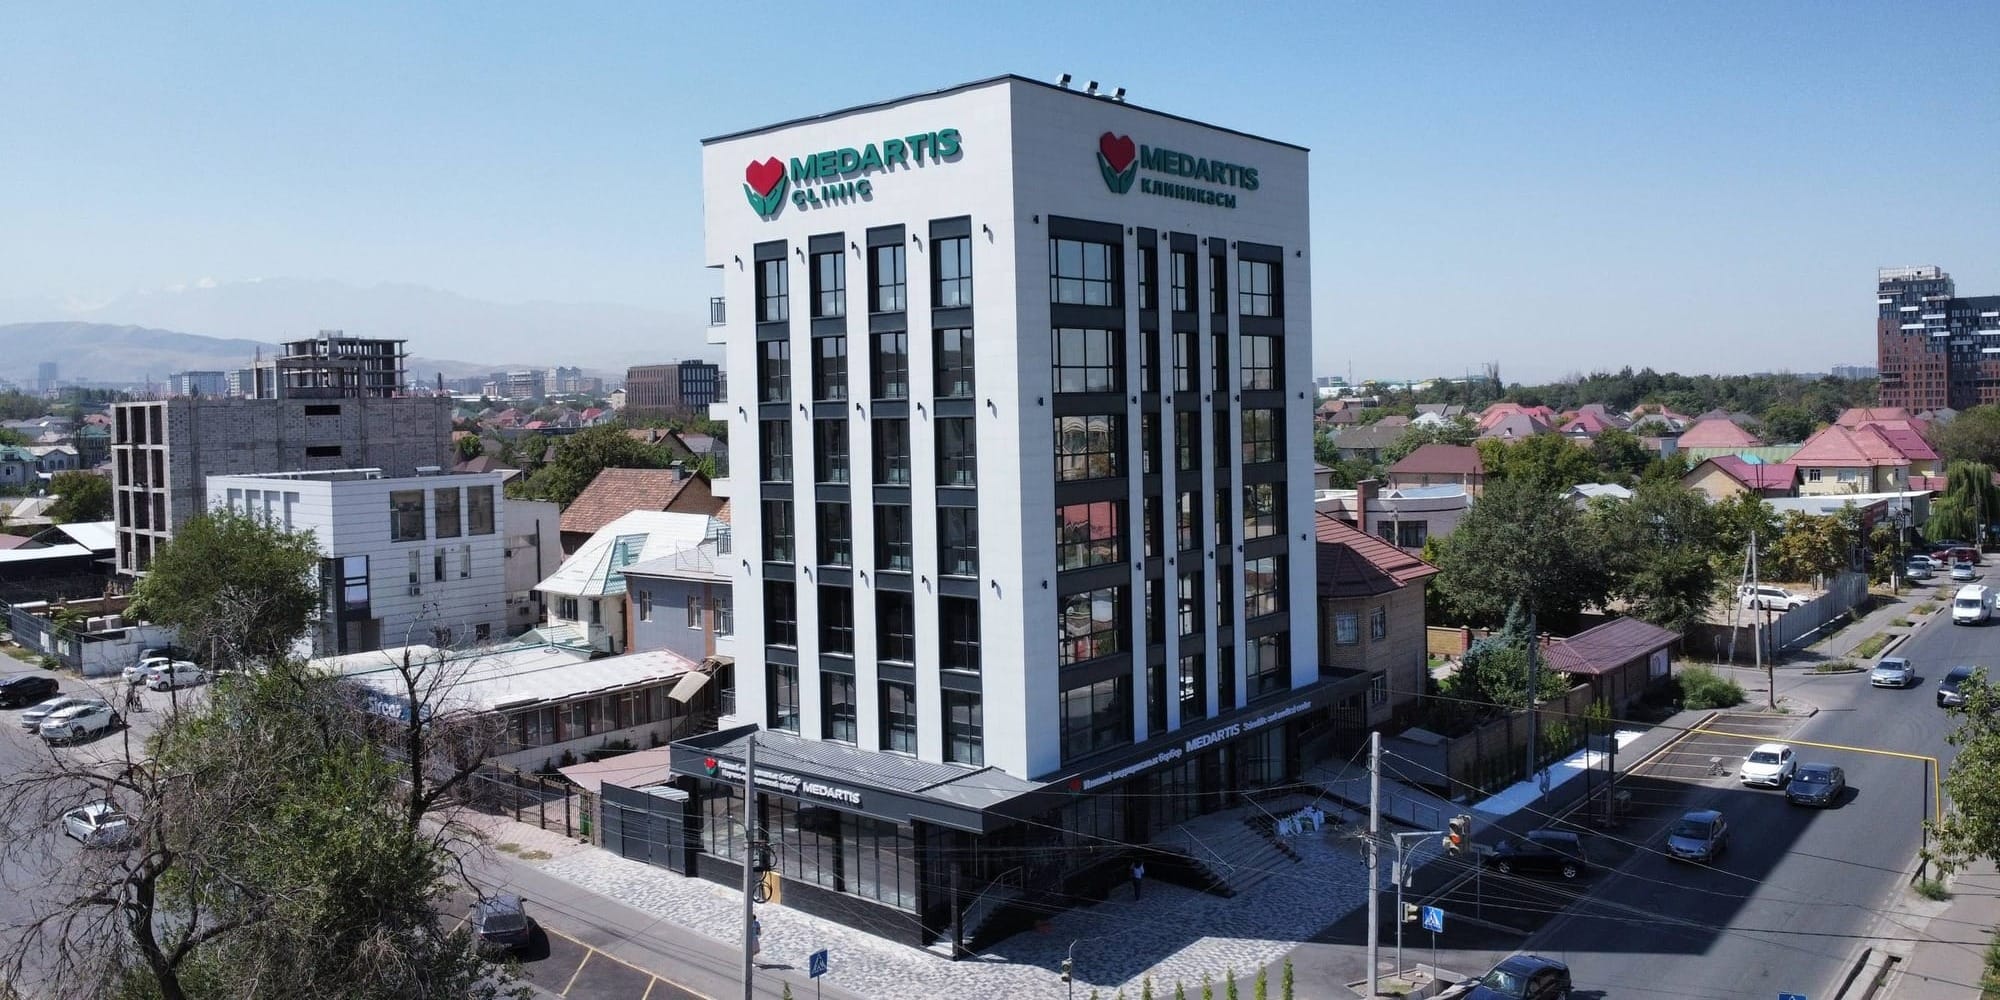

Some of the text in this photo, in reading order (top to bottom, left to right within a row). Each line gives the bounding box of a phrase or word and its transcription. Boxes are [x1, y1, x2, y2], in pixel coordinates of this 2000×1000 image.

[790, 128, 961, 182] MEDARTIS
[1140, 144, 1259, 191] MEDARTIS
[791, 178, 871, 205] CLINIC
[1185, 723, 1240, 753] MEDARTIS
[802, 781, 861, 804] MEDARTIS
